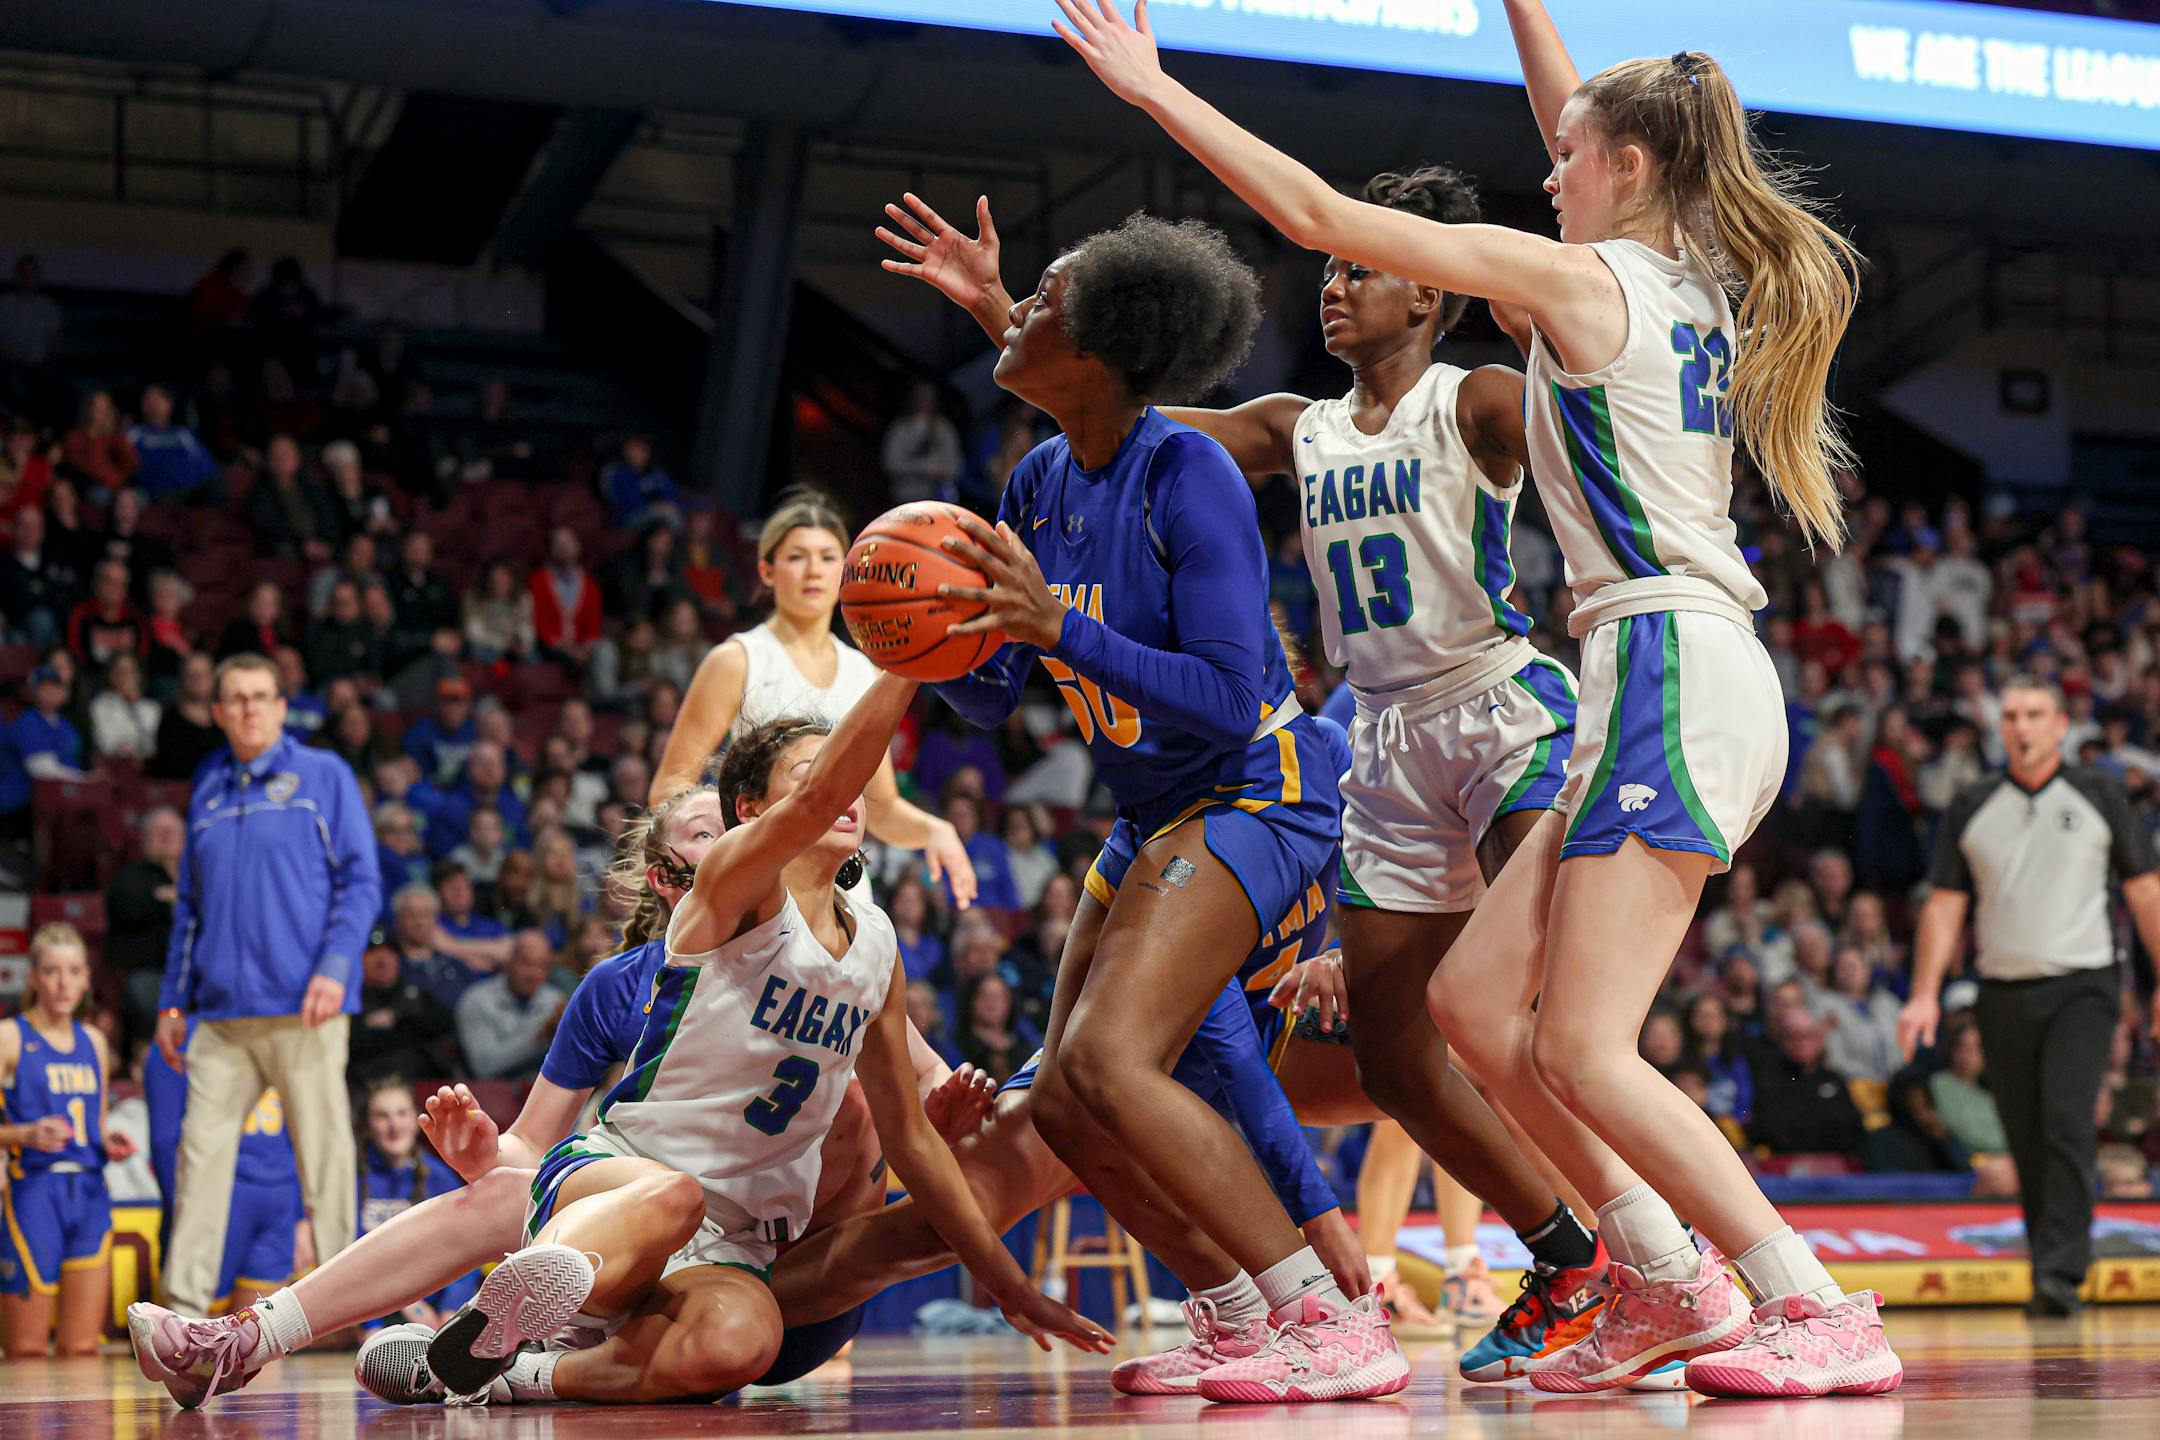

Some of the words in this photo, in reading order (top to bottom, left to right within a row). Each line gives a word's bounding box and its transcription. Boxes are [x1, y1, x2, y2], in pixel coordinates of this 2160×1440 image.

[1849, 24, 1910, 83] WE
[1914, 32, 1980, 91] ARE
[1983, 38, 2050, 97] THE
[1305, 458, 1421, 528] EAGAN
[1327, 533, 1415, 635] 13
[45, 1063, 98, 1095] STMA
[744, 1055, 820, 1136] 3
[67, 1097, 88, 1148] 1
[1568, 1287, 1592, 1314] 13
